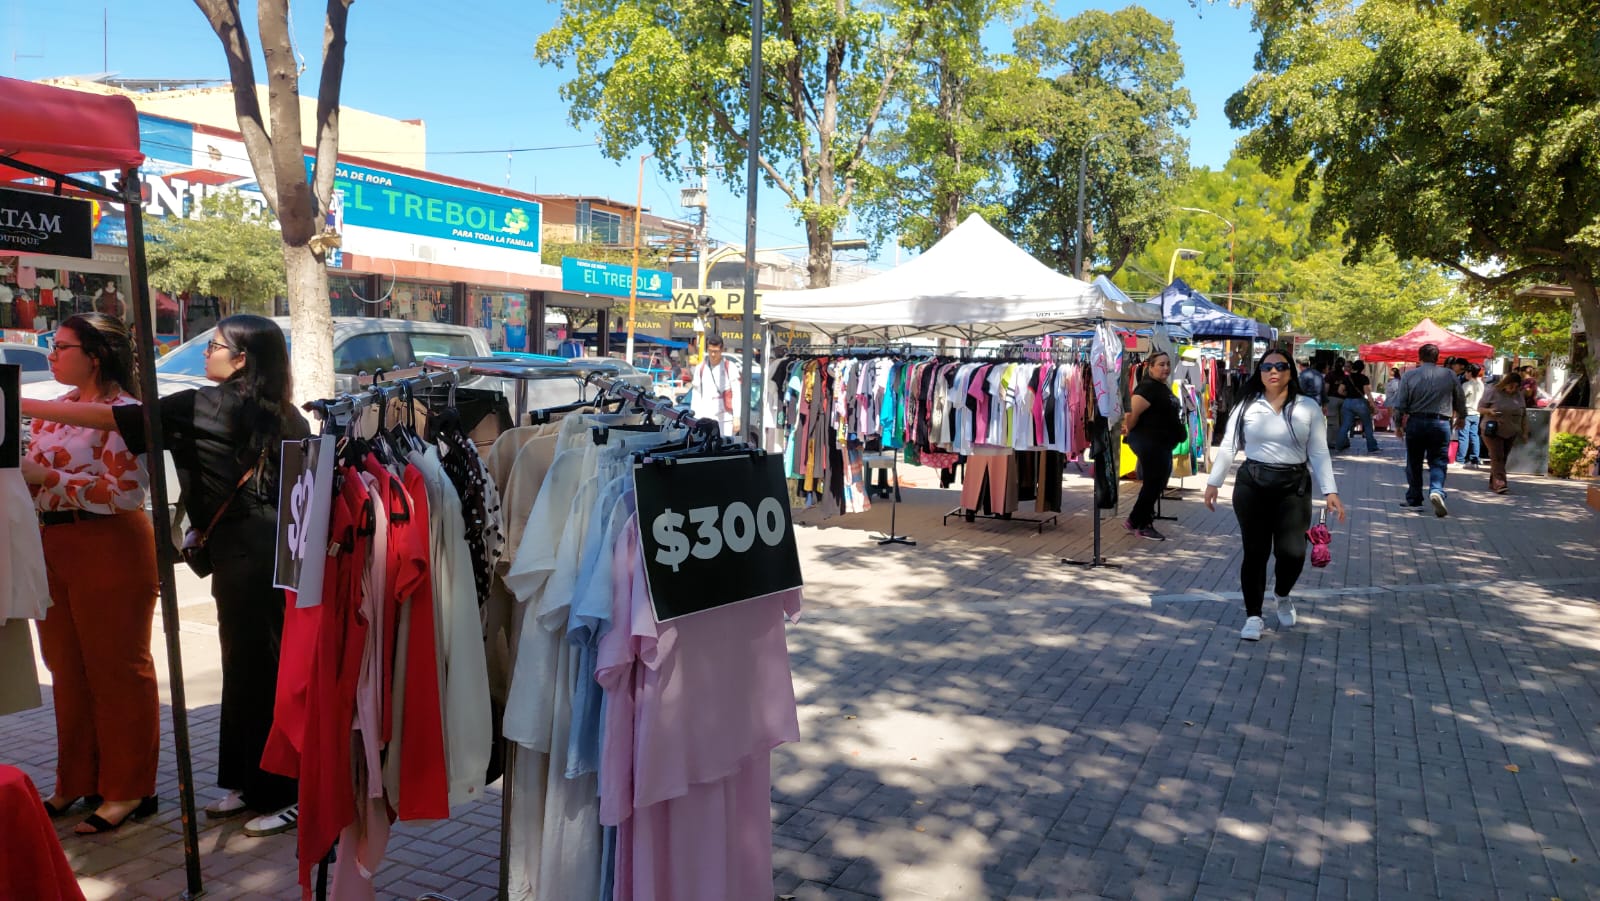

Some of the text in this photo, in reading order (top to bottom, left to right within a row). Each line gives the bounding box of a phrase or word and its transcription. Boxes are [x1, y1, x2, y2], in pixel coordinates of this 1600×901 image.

[350, 171, 364, 181] DE
[366, 174, 392, 187] ROPA
[334, 180, 503, 233] EL TREBOL
[0, 207, 62, 233] TAM
[452, 228, 534, 248] PARA TODA LA FAMILIA
[584, 269, 600, 285] EL
[652, 496, 786, 572] $300
